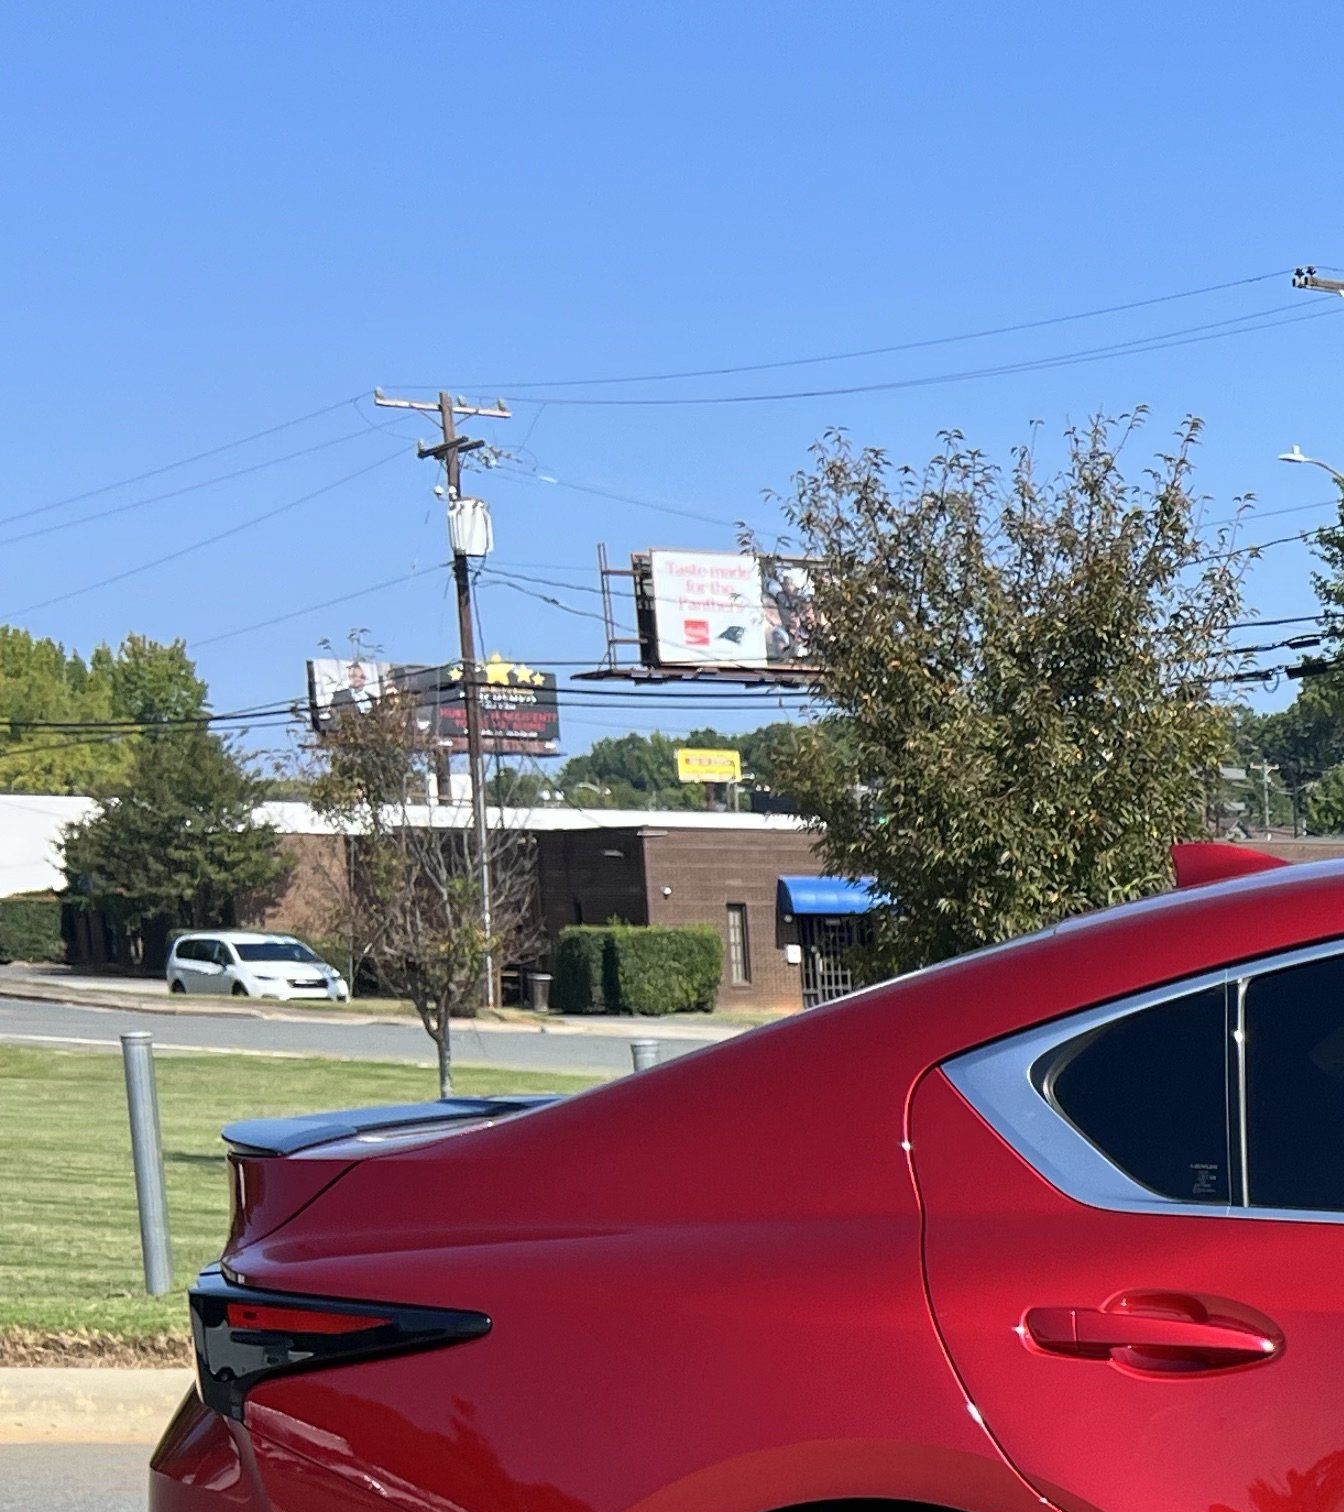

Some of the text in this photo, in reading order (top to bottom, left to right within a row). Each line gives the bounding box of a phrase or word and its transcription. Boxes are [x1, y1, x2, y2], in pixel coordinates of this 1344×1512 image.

[665, 562, 706, 577] Taste
[686, 580, 735, 594] for the
